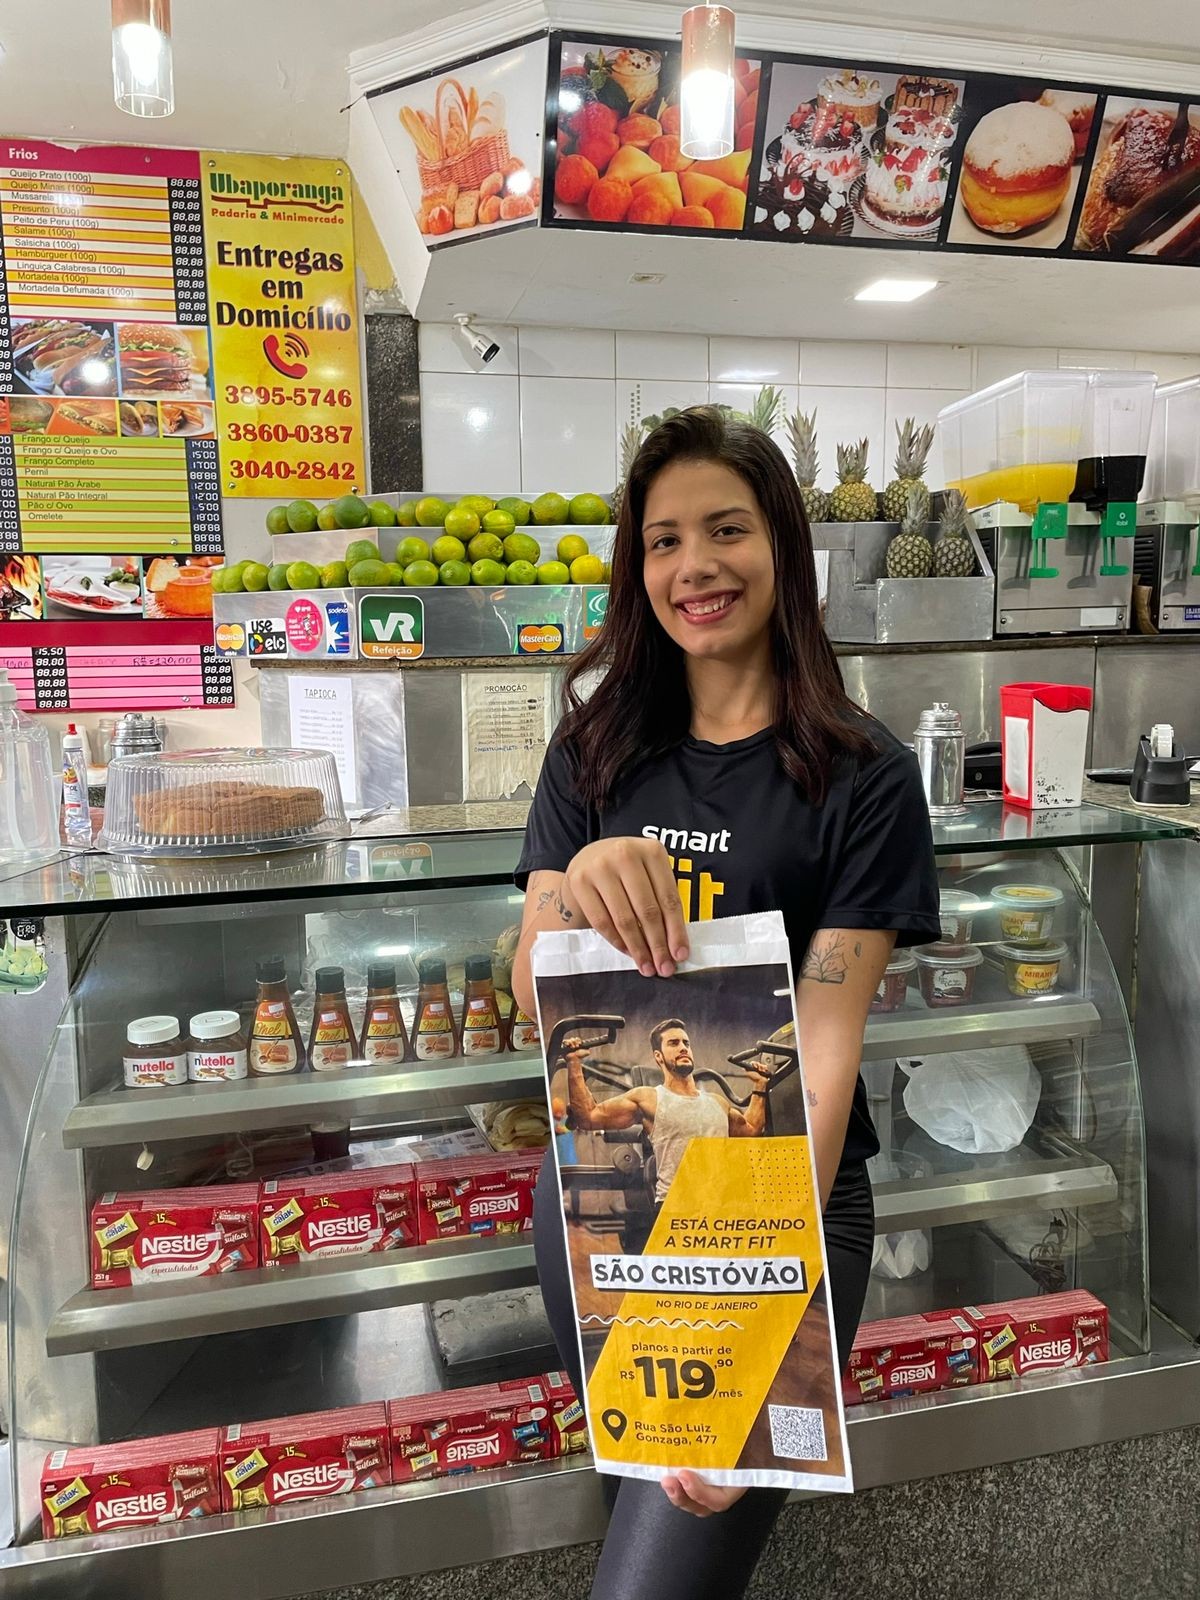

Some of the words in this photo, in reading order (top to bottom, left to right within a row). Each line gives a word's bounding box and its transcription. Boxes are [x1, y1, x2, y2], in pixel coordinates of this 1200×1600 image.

[9, 148, 38, 160] Frios
[10, 169, 37, 180] Queijo
[40, 171, 62, 180] Prato
[64, 173, 91, 183] (100g)
[11, 181, 38, 191] Queijo
[210, 173, 343, 205] Ubaporanga
[12, 204, 50, 214] Presunto
[53, 205, 80, 216] (100g)
[212, 208, 256, 219] Padaria
[260, 211, 268, 219] &
[273, 212, 344, 224] Minimercado
[13, 216, 34, 225] Peito
[37, 217, 47, 225] de
[50, 217, 70, 226] Peru
[72, 219, 99, 229] (100g)
[14, 226, 46, 236] Salame
[48, 228, 75, 238] (100g)
[15, 238, 50, 248] Salsicha
[53, 240, 80, 250] (100g)
[70, 251, 97, 261] (100g)
[217, 241, 343, 275] Entregas
[17, 262, 52, 272] Linguiça
[54, 263, 96, 273] Calabresa
[98, 265, 125, 276] (100g)
[18, 272, 59, 282] Mortadela
[62, 273, 88, 283] (100g)
[19, 284, 60, 294] Mortadela
[62, 286, 105, 295] Defumada
[262, 279, 303, 299] em
[216, 301, 351, 331] Domicílio
[226, 385, 352, 407] 3895-5746
[228, 423, 353, 444] 3860-0387
[22, 435, 51, 444] Frango
[64, 436, 90, 445] Queijo
[23, 446, 52, 455] Frango
[64, 447, 90, 456] Queijo
[23, 457, 53, 466] Frango
[56, 458, 95, 467] Completo
[25, 468, 48, 476] Pernil
[230, 460, 355, 480] 3040-2842
[26, 480, 56, 488] Natural
[58, 480, 75, 488] Pão
[27, 491, 57, 500] Natural
[59, 492, 76, 500] Pão
[78, 492, 108, 501] Integral
[56, 502, 73, 510] Ovo
[29, 512, 63, 520] Omelete
[520, 634, 560, 643] MasterCard
[372, 645, 412, 655] Refeição
[304, 689, 336, 699] TAPIOCA
[642, 825, 731, 853] smart
[132, 1061, 174, 1072] nutella
[195, 1056, 234, 1066] nutella
[320, 1197, 329, 1206] 15
[469, 1197, 519, 1217] Nestlé
[157, 1213, 165, 1222] 15
[308, 1213, 371, 1240] Nestlé
[670, 1216, 709, 1232] ESTÁ
[713, 1218, 806, 1232] CHEGANDO
[142, 1234, 209, 1255] Nestlé
[664, 1237, 678, 1248] A
[682, 1236, 743, 1250] SMART
[749, 1236, 777, 1249] FIT
[594, 1258, 644, 1283] SÃO
[651, 1262, 799, 1286] CRISTÓVÃO
[656, 1301, 672, 1309] NO
[674, 1301, 693, 1309] RIO
[711, 1302, 758, 1311] JANEIRO
[1029, 1323, 1038, 1332] 15
[631, 1342, 669, 1353] planos
[682, 1345, 714, 1356] partir
[717, 1345, 732, 1355] de
[1019, 1338, 1072, 1363] Nestlé
[620, 1371, 635, 1381] R$
[890, 1366, 936, 1386] Nestlé
[634, 1421, 657, 1432] Rua
[660, 1423, 683, 1433] São
[686, 1423, 711, 1433] Luiz
[636, 1433, 692, 1446] Gonzaga,
[696, 1435, 718, 1445] 477
[285, 1446, 295, 1456] 15
[446, 1439, 499, 1463] Nestlé
[108, 1475, 119, 1485] 15
[272, 1462, 340, 1491] Nestlé
[95, 1492, 167, 1520] Nestlé
